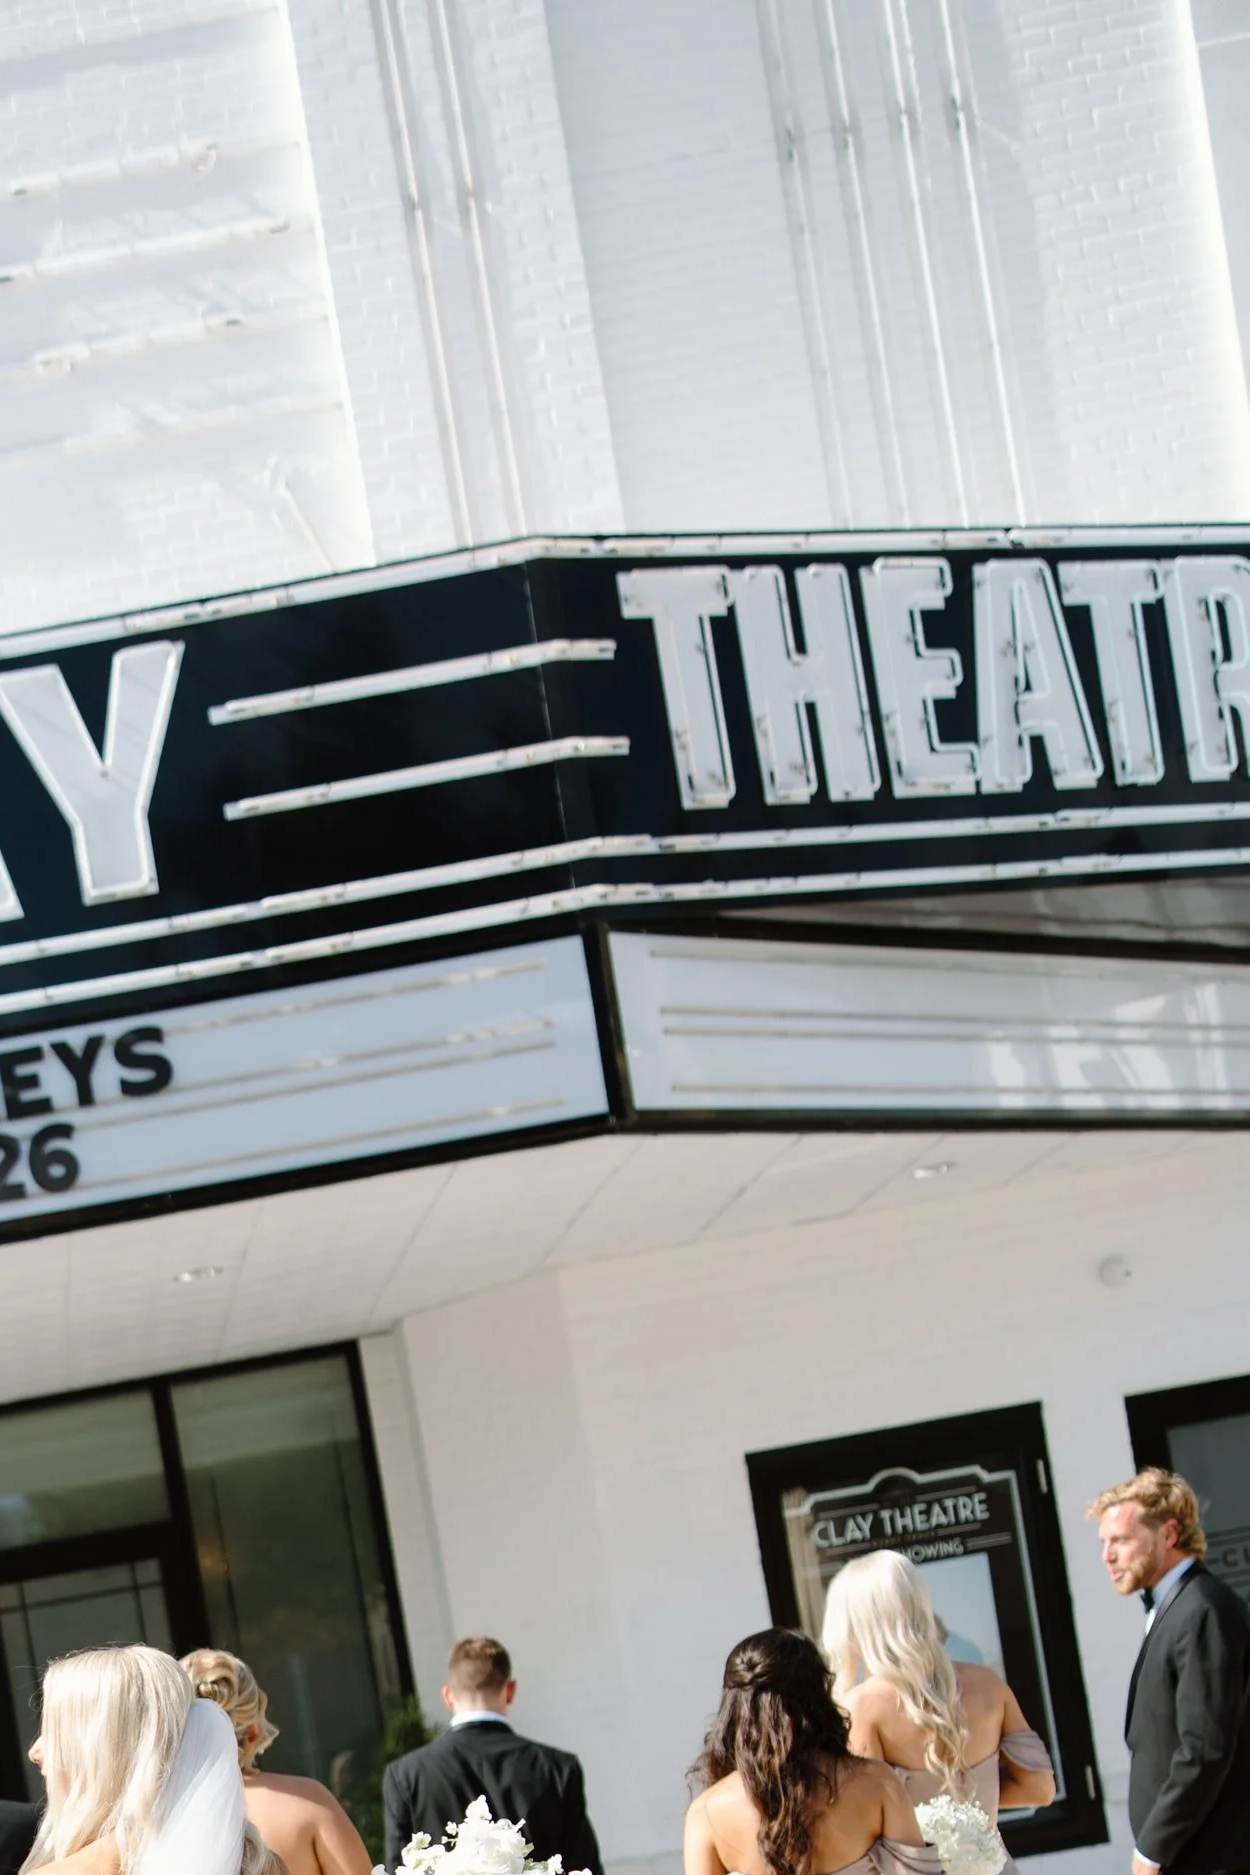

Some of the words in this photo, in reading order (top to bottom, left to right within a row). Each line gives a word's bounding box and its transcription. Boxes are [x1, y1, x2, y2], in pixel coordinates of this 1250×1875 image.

[616, 554, 1250, 811] THEATR
[810, 1511, 874, 1549] CLAY
[879, 1492, 991, 1537] THEATRE
[893, 1536, 964, 1563] HOWING
